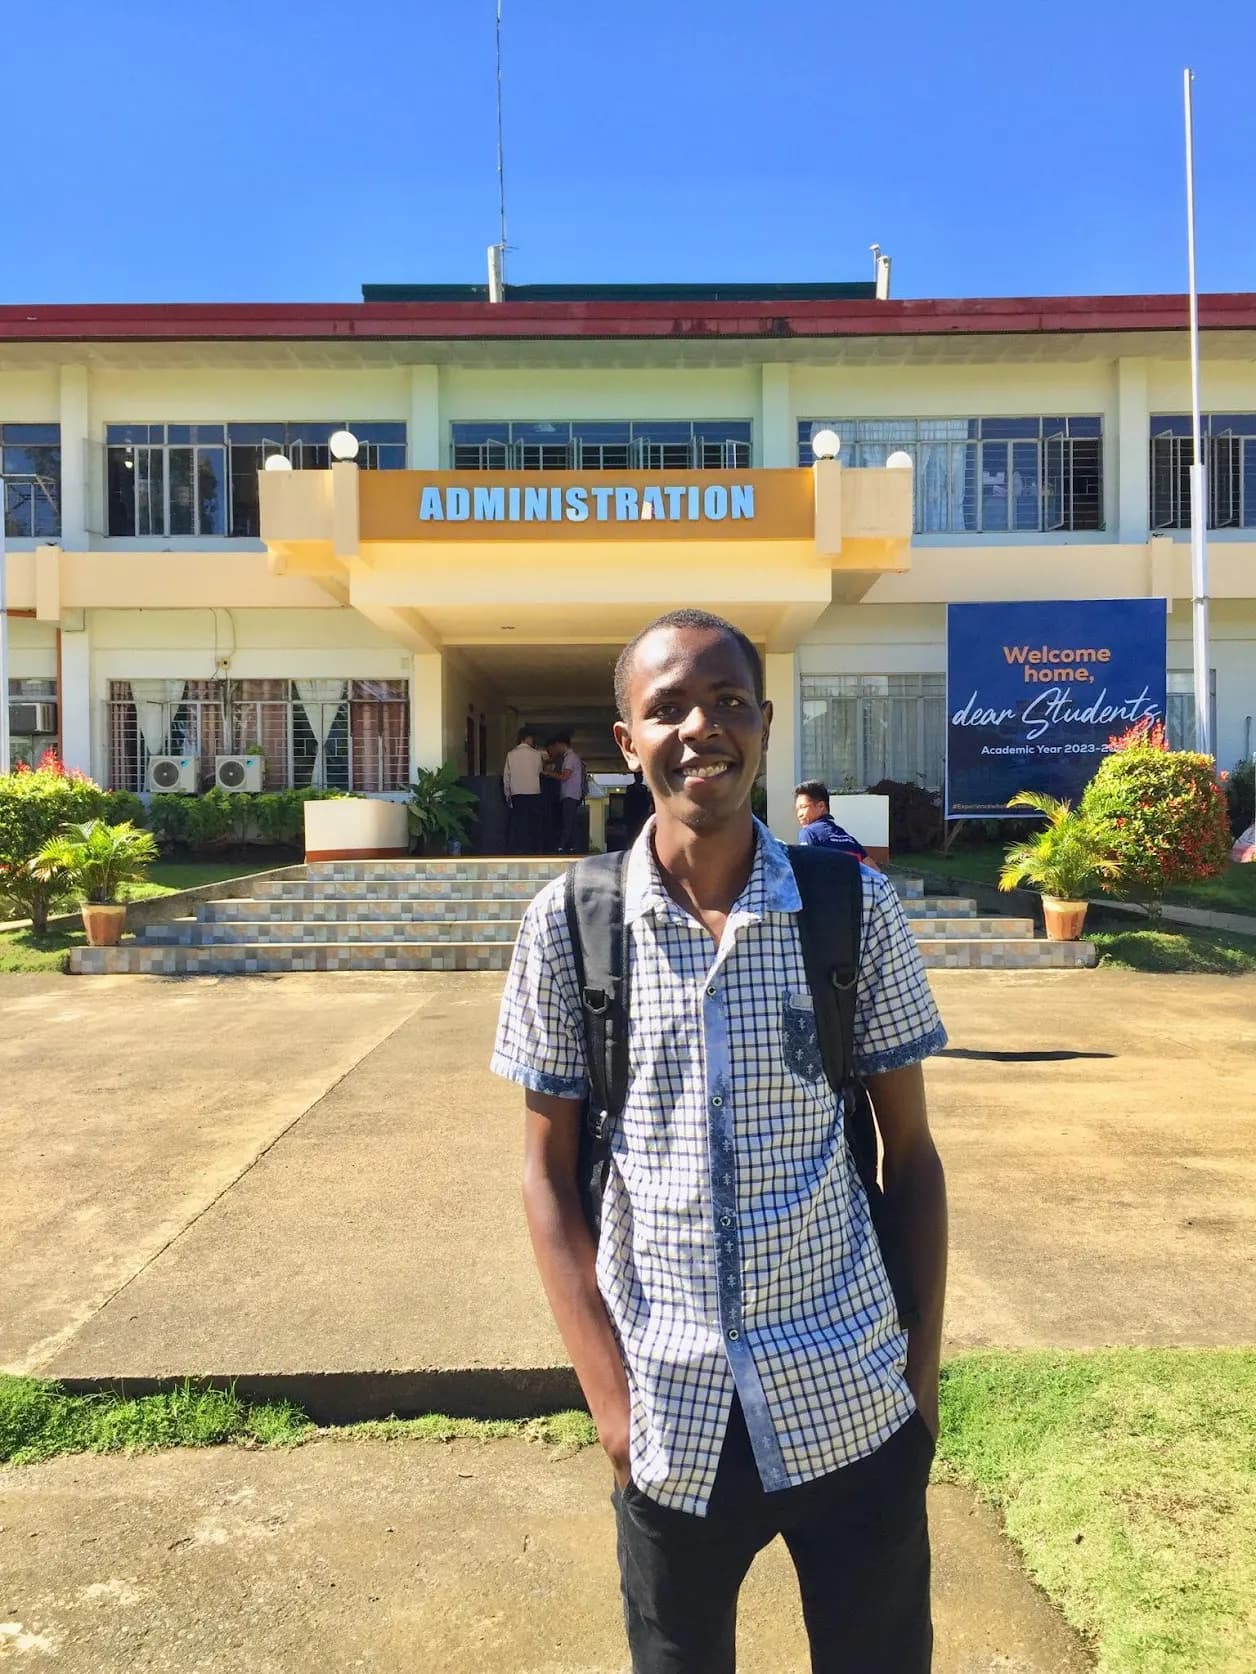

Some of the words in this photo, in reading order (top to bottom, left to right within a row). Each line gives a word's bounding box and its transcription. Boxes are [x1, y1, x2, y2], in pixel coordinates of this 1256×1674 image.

[419, 485, 755, 521] ADMINISTRATION
[1003, 646, 1111, 664] Welcome
[1024, 665, 1095, 684] home,
[951, 690, 1015, 726] dear
[981, 745, 1035, 755] Academic
[1037, 744, 1061, 754] Year
